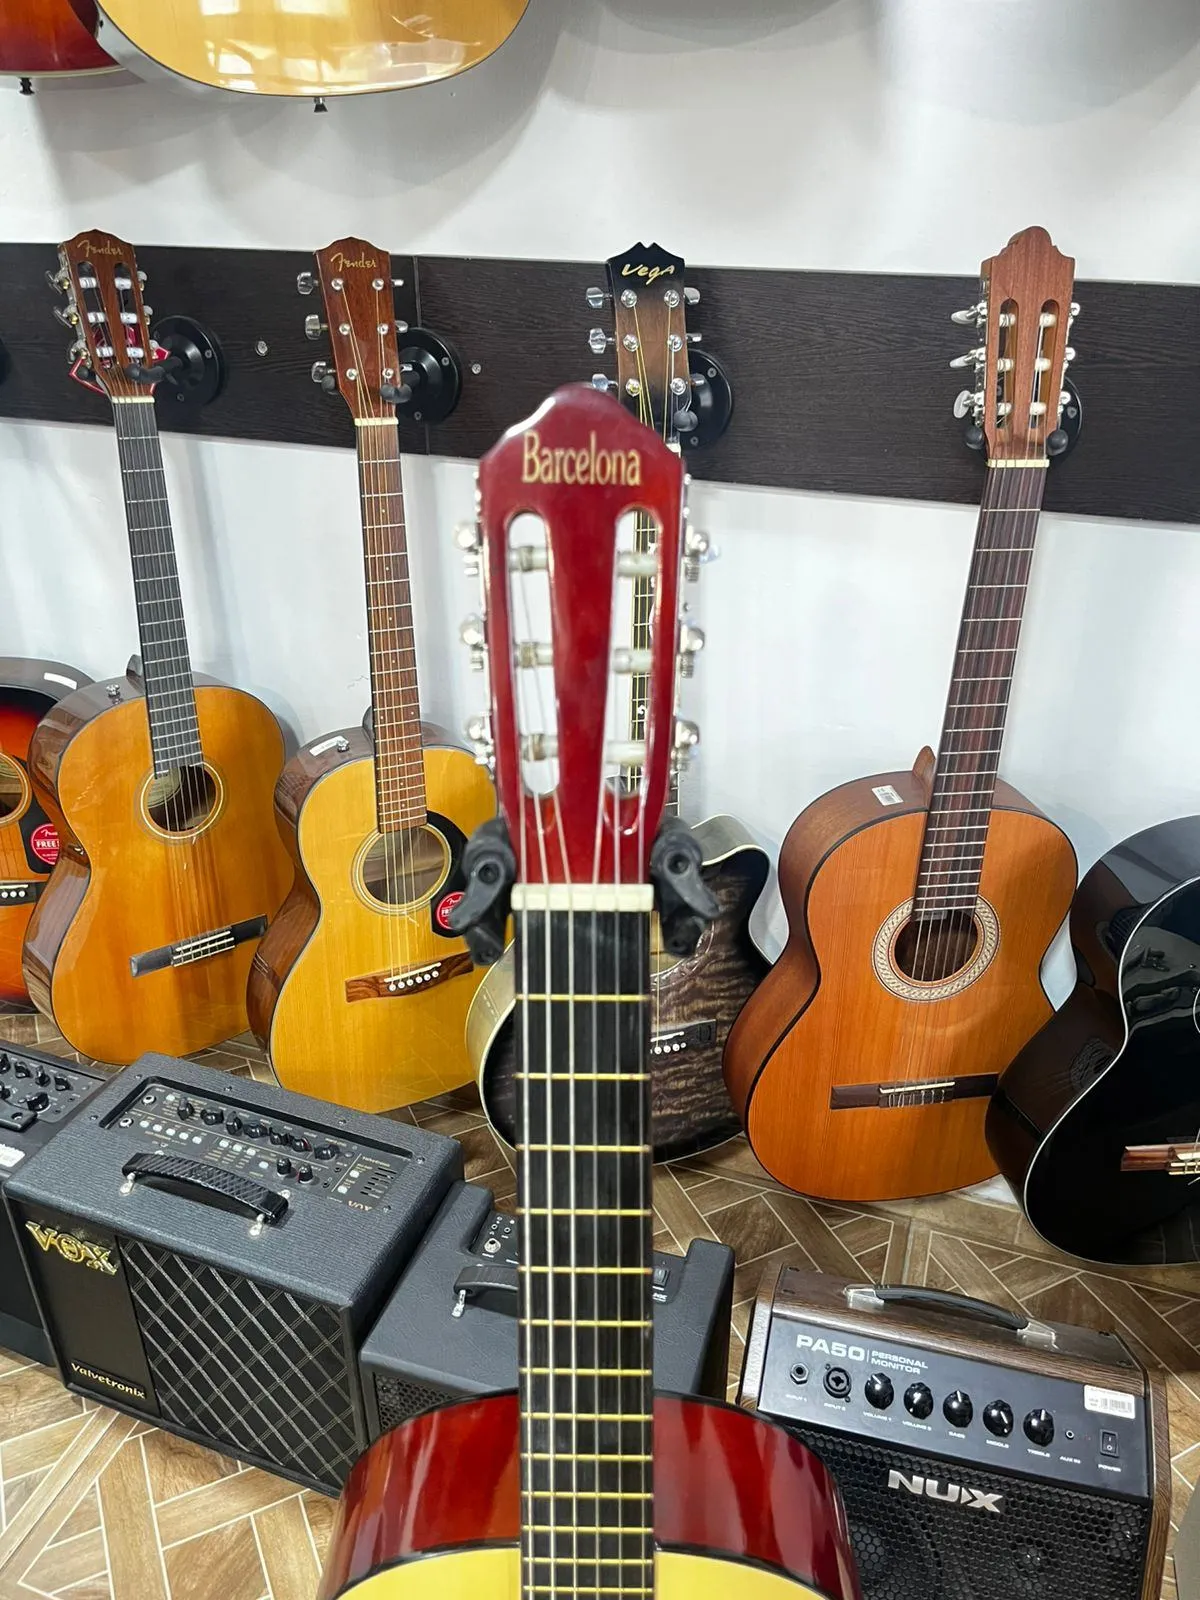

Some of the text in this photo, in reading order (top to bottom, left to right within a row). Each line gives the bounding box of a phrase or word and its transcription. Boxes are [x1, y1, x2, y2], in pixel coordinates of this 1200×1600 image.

[76, 239, 123, 258] Fender
[330, 251, 376, 272] Fender
[621, 263, 675, 285] Vega
[522, 430, 641, 486] Barcelona
[25, 1220, 117, 1275] VOX
[796, 1334, 865, 1362] PA50
[871, 1350, 928, 1369] PERSONAL
[871, 1357, 920, 1375] MONITOR
[71, 1362, 146, 1399] Valvetronix
[888, 1469, 1003, 1513] NUX
